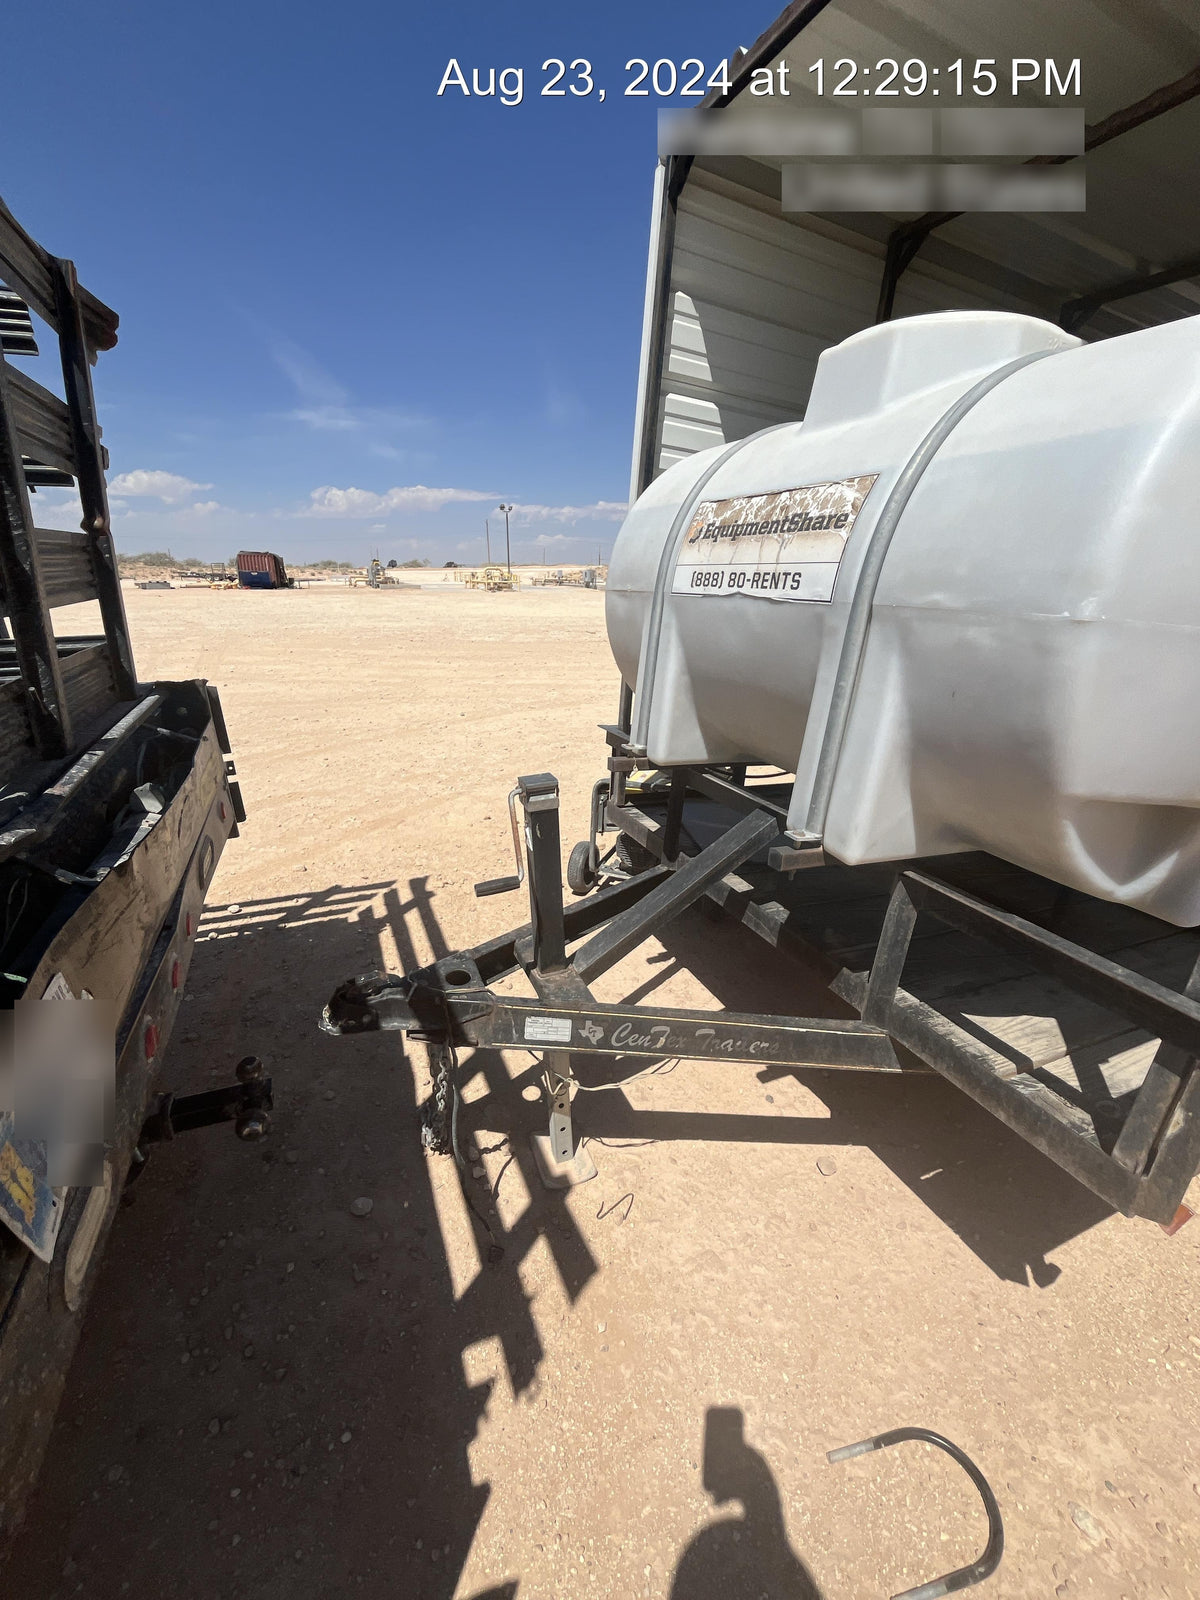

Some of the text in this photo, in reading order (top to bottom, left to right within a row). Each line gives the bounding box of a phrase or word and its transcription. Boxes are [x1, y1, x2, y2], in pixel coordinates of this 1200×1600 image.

[702, 511, 849, 543] EquipmentShare
[690, 570, 802, 591] (888) 80-RENTS
